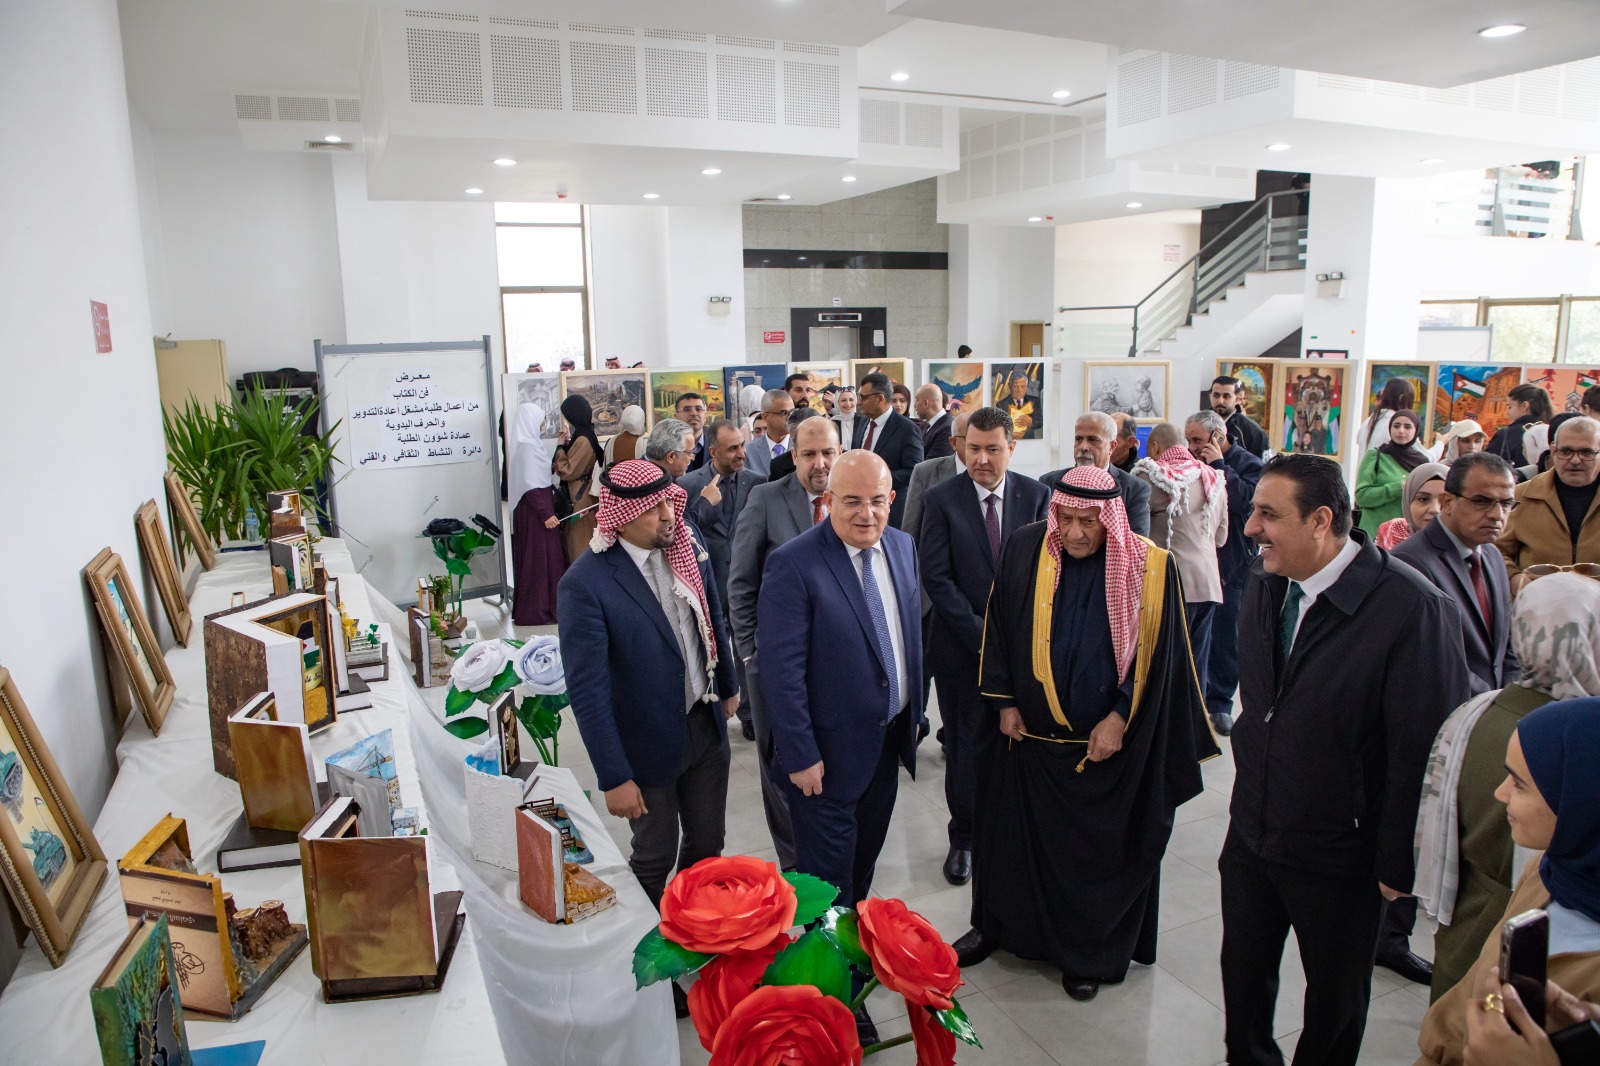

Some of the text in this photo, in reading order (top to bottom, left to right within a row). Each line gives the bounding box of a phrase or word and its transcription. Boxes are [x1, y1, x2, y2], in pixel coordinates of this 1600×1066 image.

[396, 372, 430, 382] معرض
[393, 387, 429, 400] فن الكتاب
[401, 404, 424, 416] مشغل
[425, 402, 442, 414] طلبة
[444, 400, 465, 412] أعمال
[468, 402, 479, 411] من
[386, 418, 446, 431] والحرف اليدوية
[397, 431, 471, 445] عمادة شؤون الطلبة
[360, 446, 482, 465] دائرة النشاط الثقافي والفني
